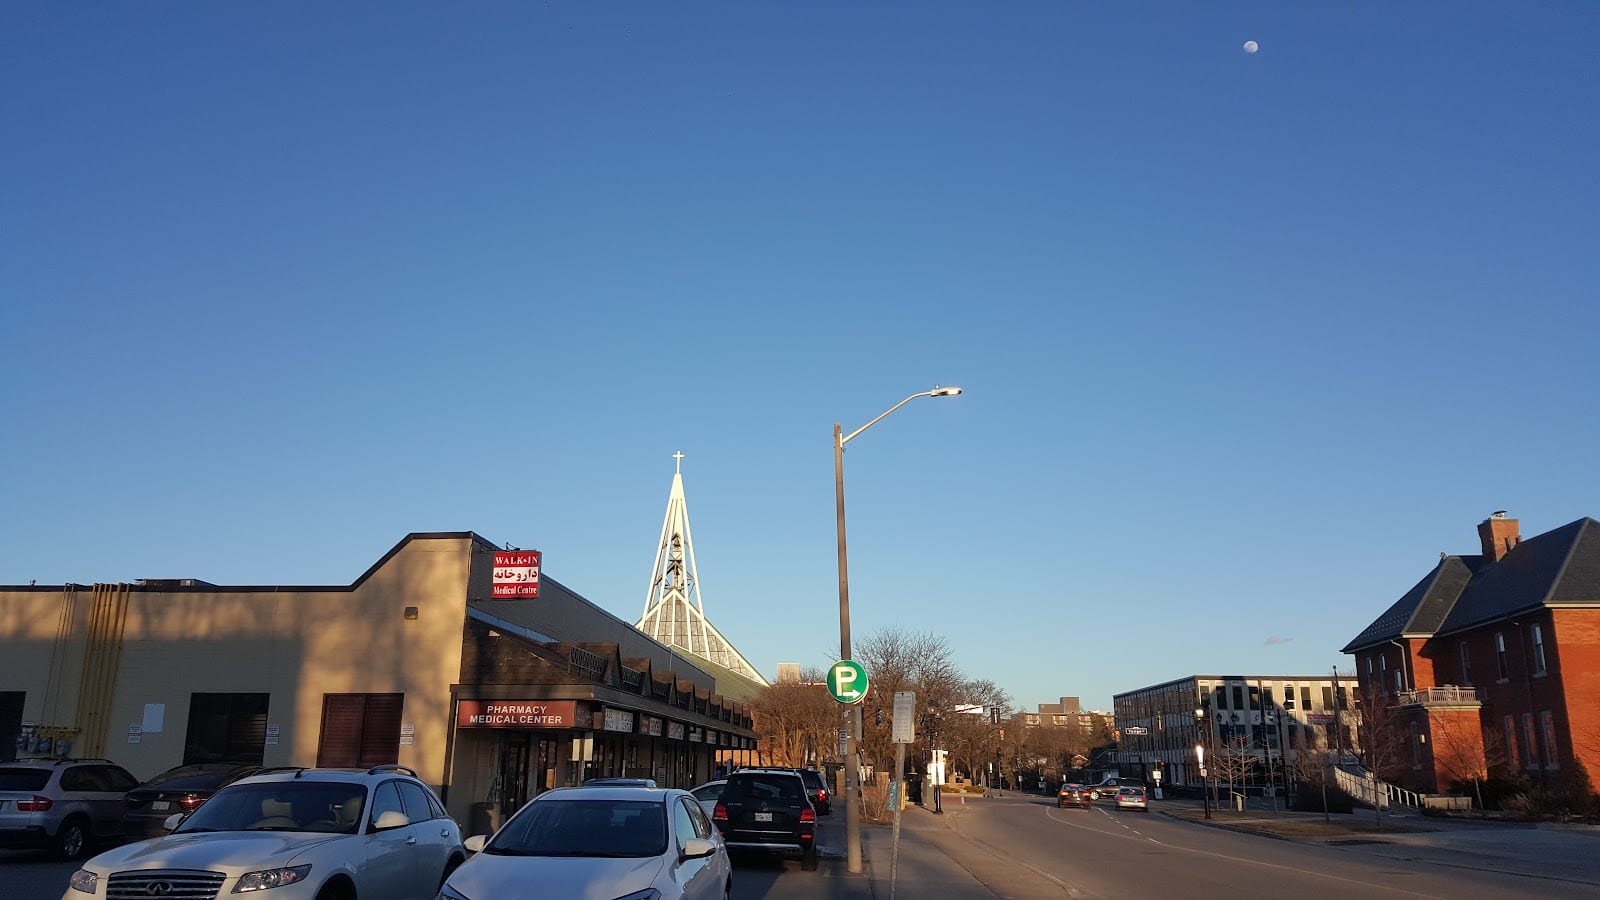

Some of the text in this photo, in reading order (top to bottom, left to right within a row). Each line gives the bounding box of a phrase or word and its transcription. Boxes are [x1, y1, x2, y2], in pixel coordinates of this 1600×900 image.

[493, 585, 537, 595] Medical Centre
[835, 666, 858, 697] P
[486, 705, 547, 714] PHARMACY
[469, 714, 562, 724] MEDICAL CENTER
